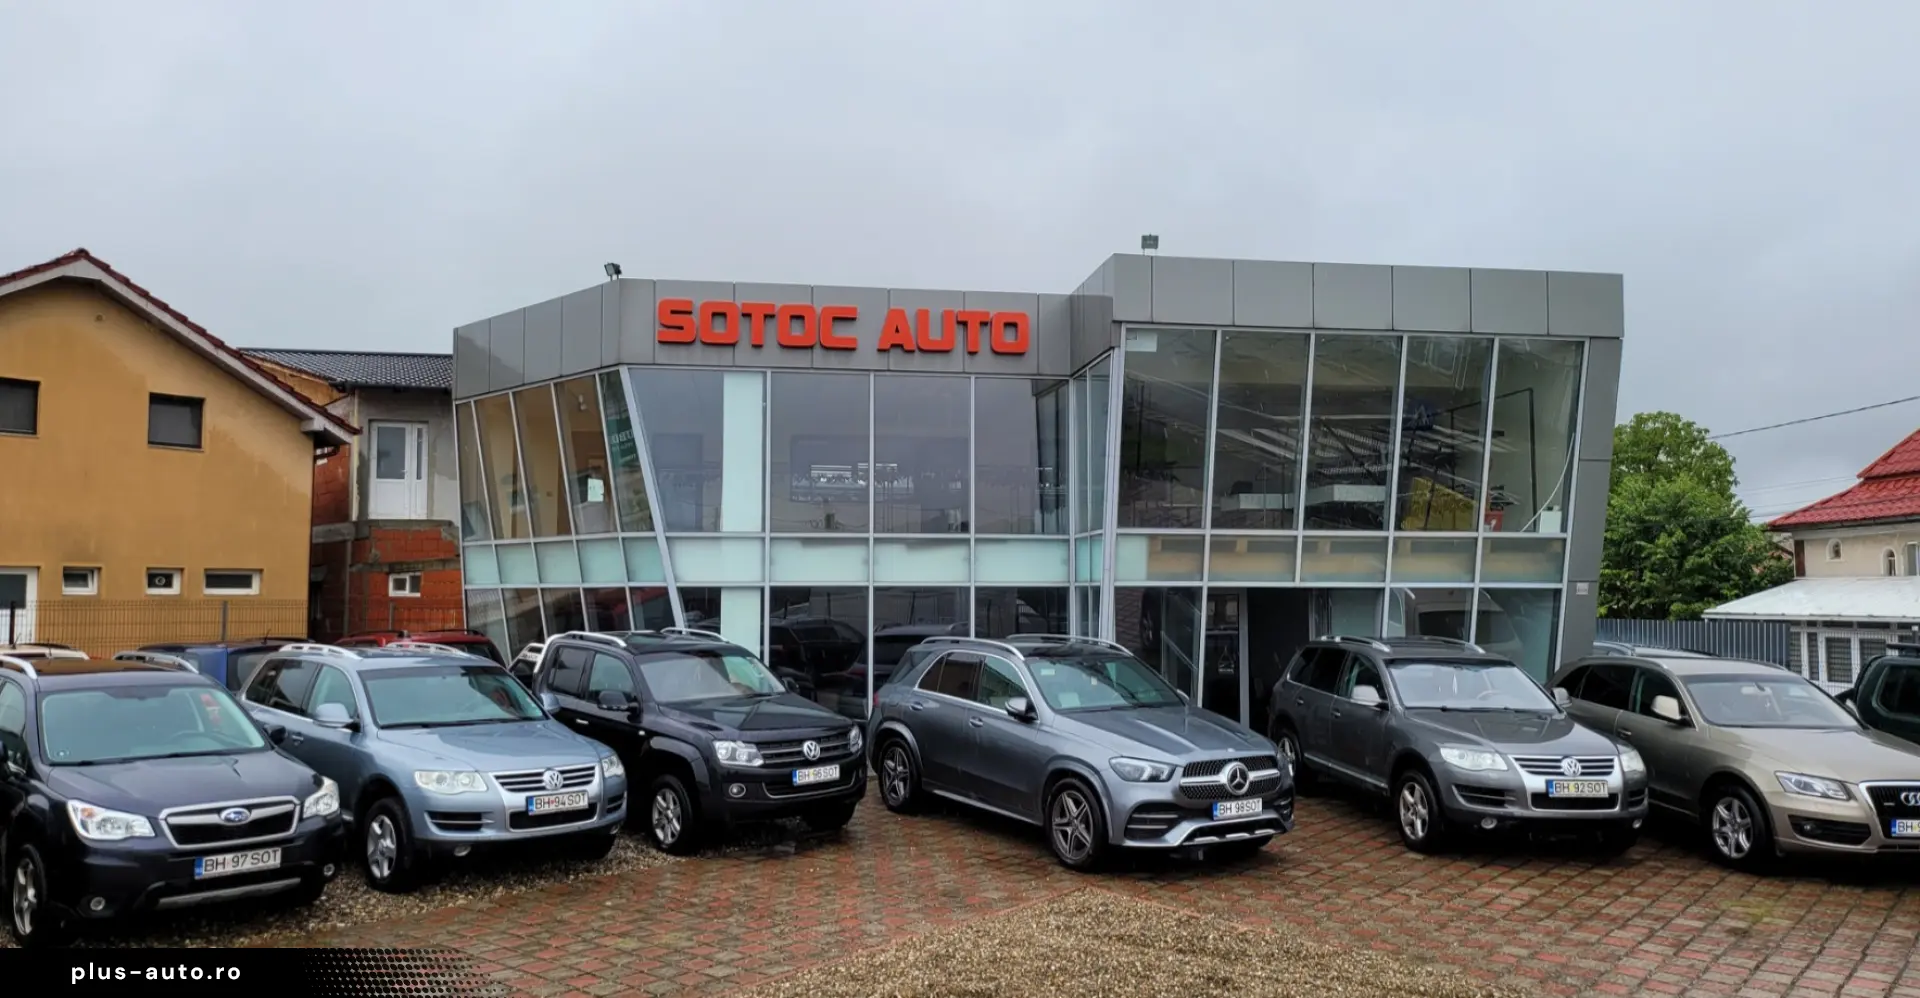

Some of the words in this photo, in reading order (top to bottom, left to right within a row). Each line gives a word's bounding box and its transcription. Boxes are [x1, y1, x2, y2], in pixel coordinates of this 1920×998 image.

[656, 299, 858, 350] SOTOC
[877, 308, 1030, 355] AUTO
[1554, 783, 1570, 793] BH
[1574, 783, 1585, 793] 92
[1587, 782, 1606, 793] SOT
[535, 798, 551, 809] BH
[554, 796, 566, 807] 94
[567, 793, 586, 805] SOT
[1219, 804, 1233, 814] BH
[204, 857, 226, 872] BH
[231, 854, 248, 868] 97
[250, 849, 280, 865] SOT
